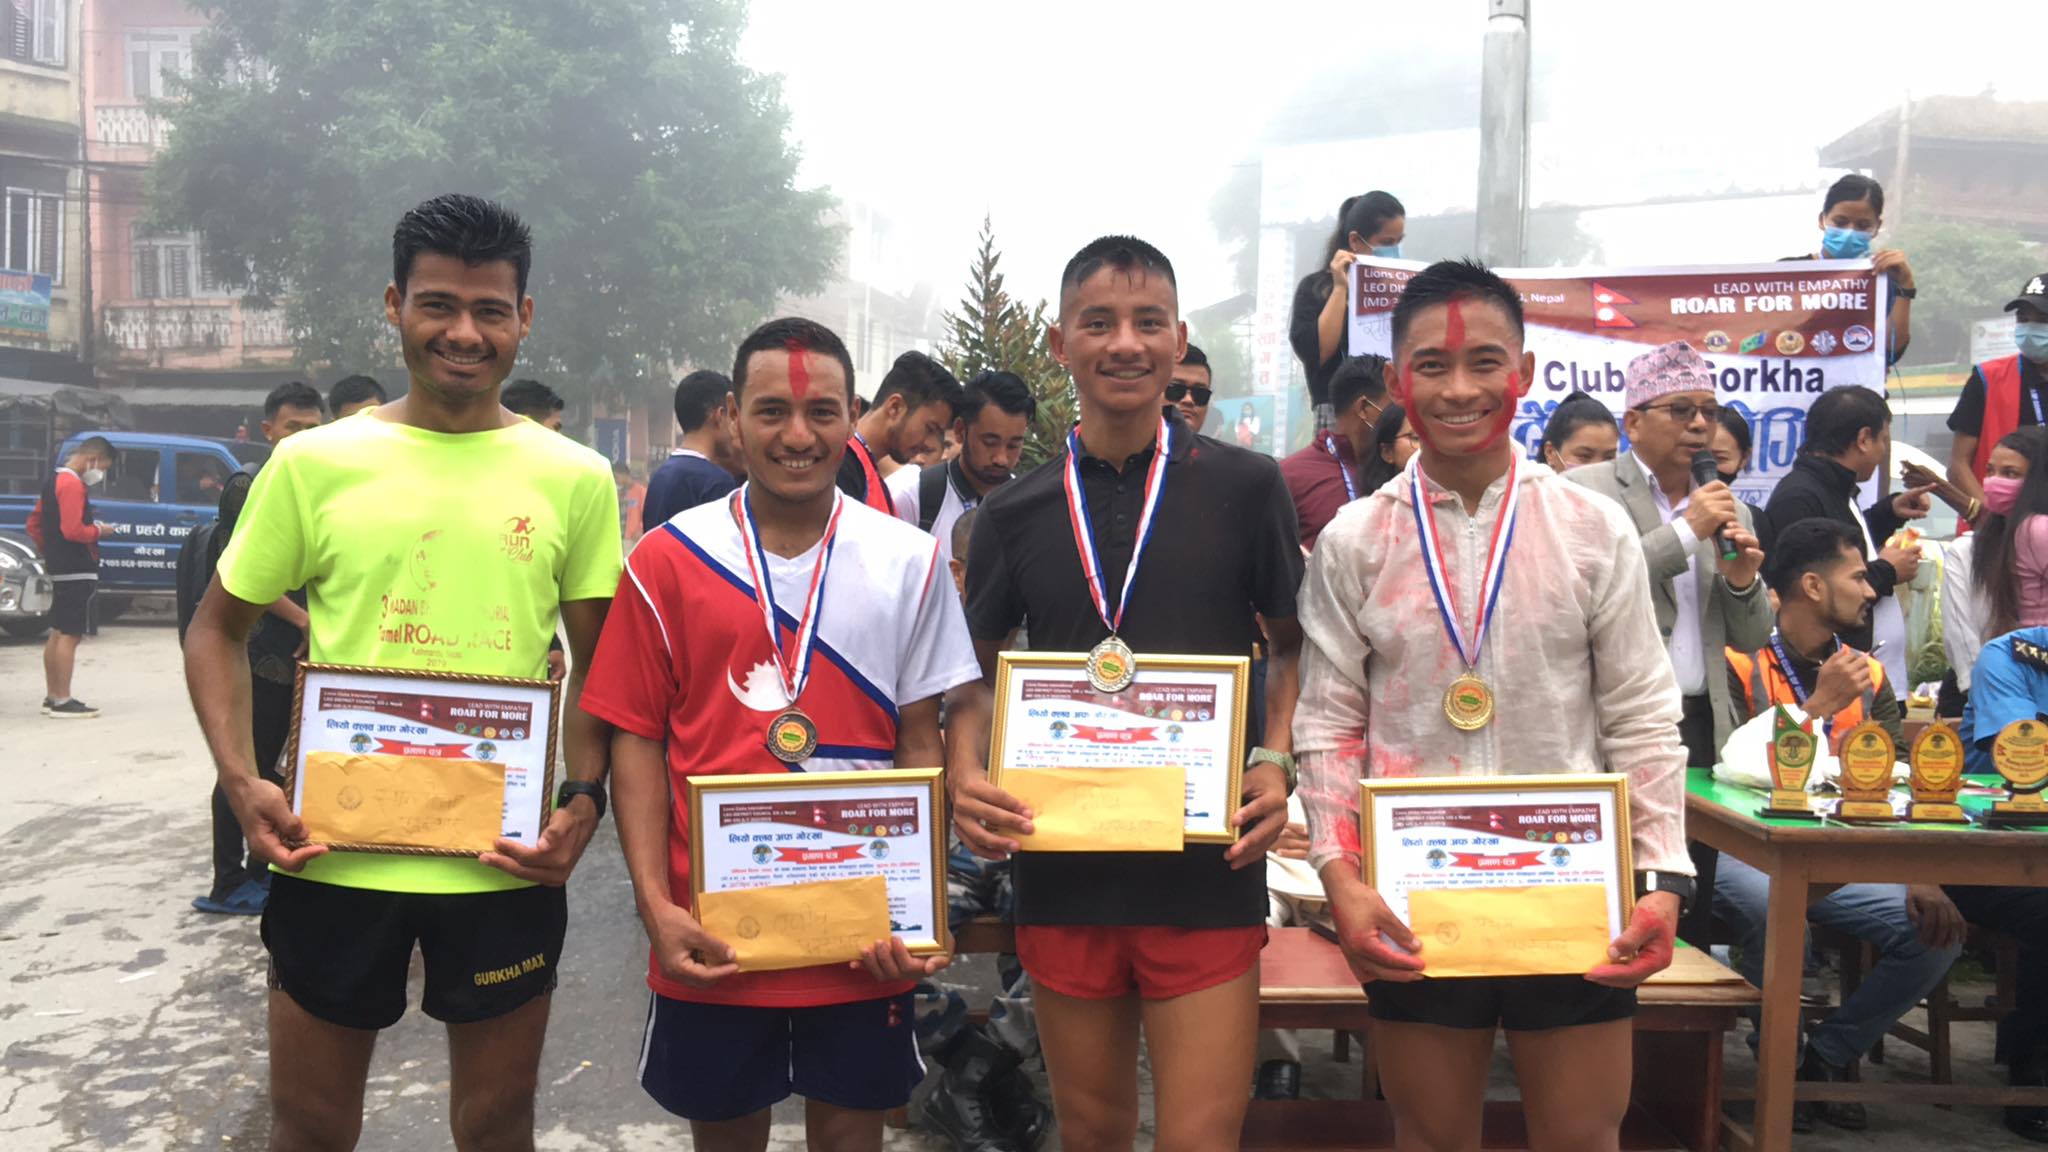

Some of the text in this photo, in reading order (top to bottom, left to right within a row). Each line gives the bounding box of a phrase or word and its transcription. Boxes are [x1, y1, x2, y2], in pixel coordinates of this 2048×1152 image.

[1363, 268, 1393, 279] Lions
[1363, 282, 1387, 293] LEO
[1530, 293, 1565, 304] Nepal
[1713, 278, 1869, 295] LEAD WITH EMPATHY
[1363, 297, 1389, 309] (MD
[1670, 292, 1868, 314] ROAR FOR MORE
[1543, 360, 1626, 393] Club
[1139, 693, 1213, 703] ROAR FOR MORE
[450, 708, 528, 721] ROAR FOR MORE
[841, 808, 915, 819] ROAR FOR MORE
[1519, 814, 1597, 825] ROAR FOR MORE
[473, 953, 546, 987] GURKHA MAX
